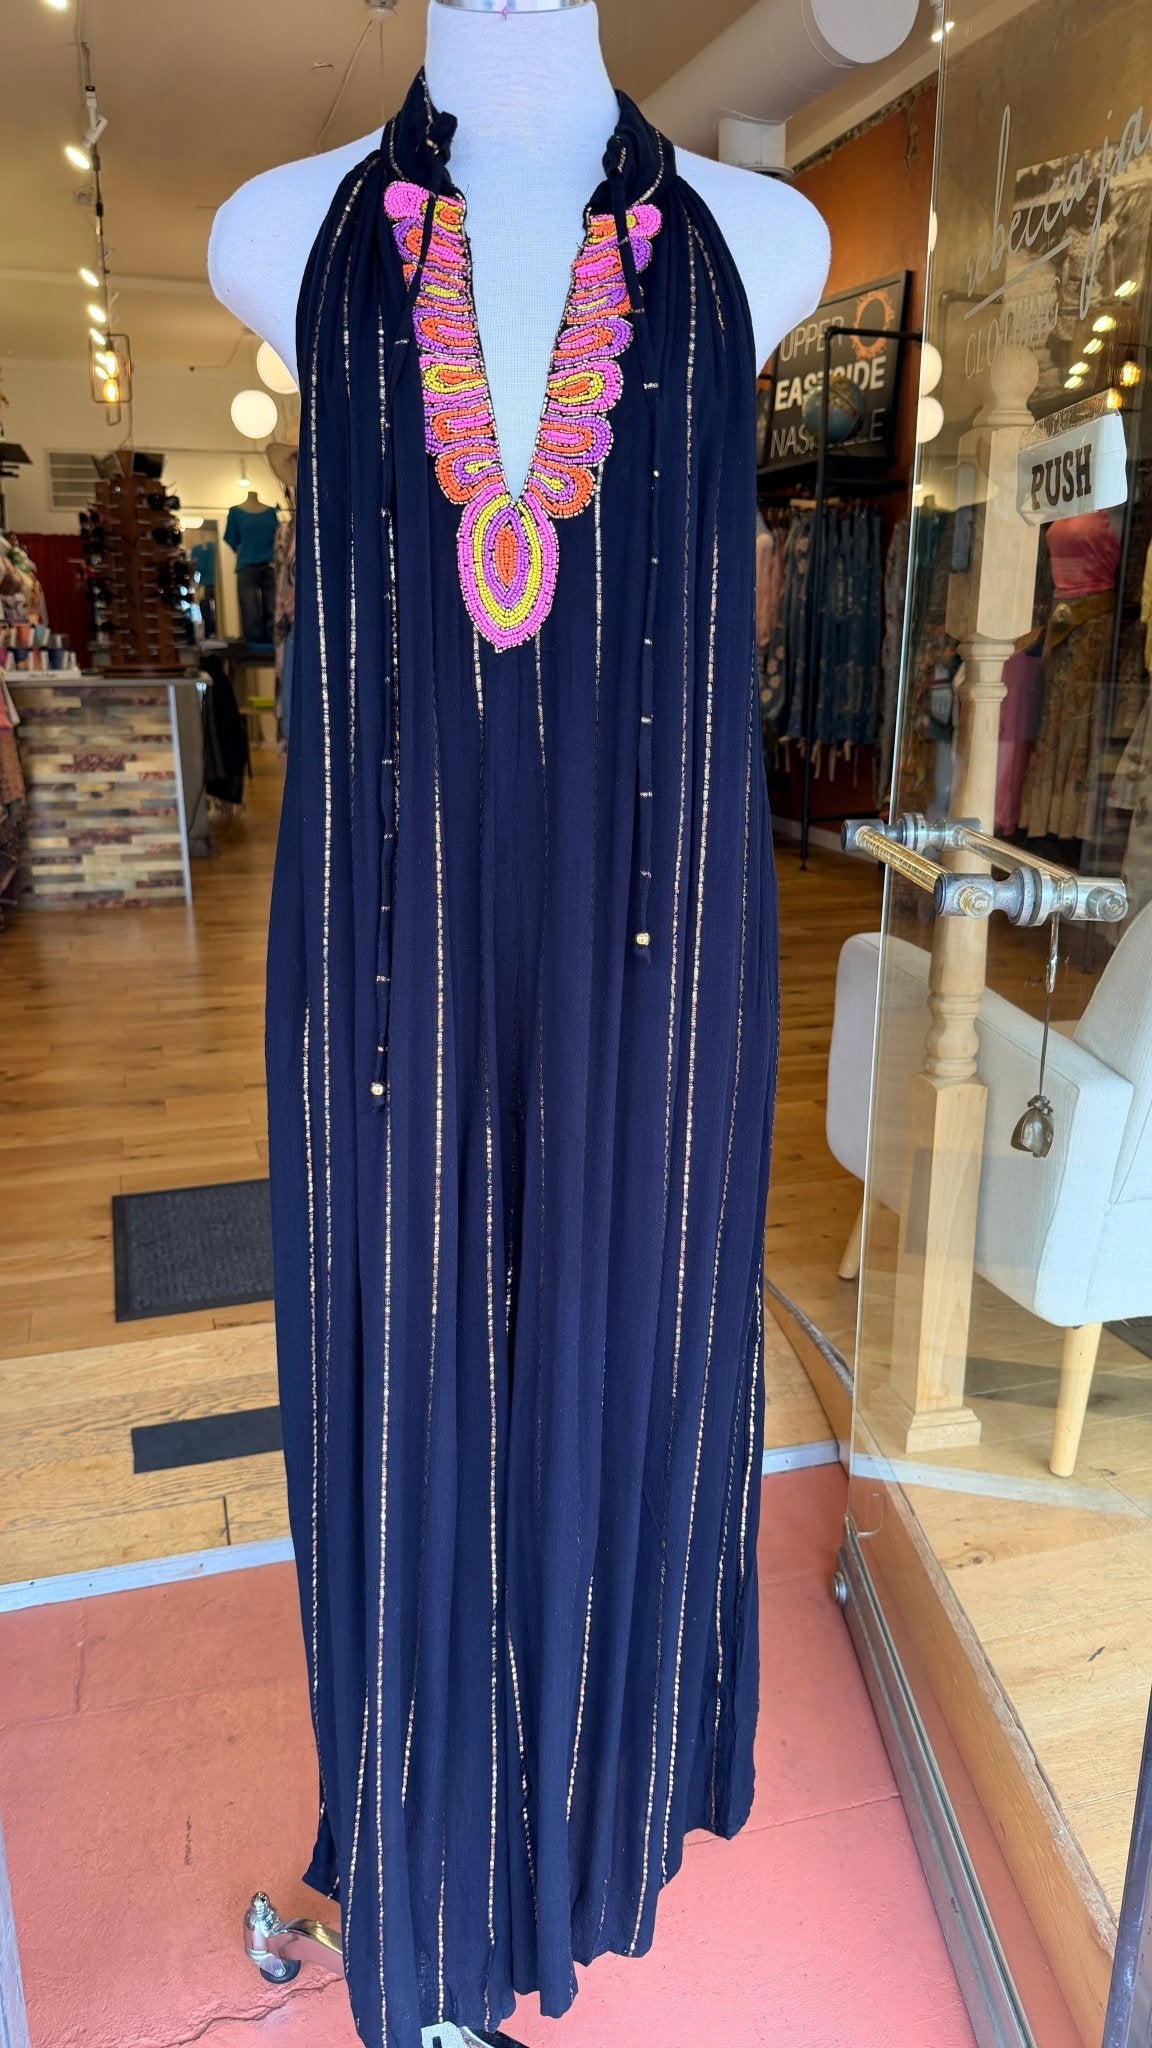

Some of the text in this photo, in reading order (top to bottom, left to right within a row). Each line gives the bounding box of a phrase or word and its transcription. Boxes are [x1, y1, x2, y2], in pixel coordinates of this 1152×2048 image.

[1079, 104, 1152, 320] ja
[780, 315, 845, 362] UPPER
[774, 355, 887, 412] EASIDE
[1031, 443, 1092, 511] PUSH
